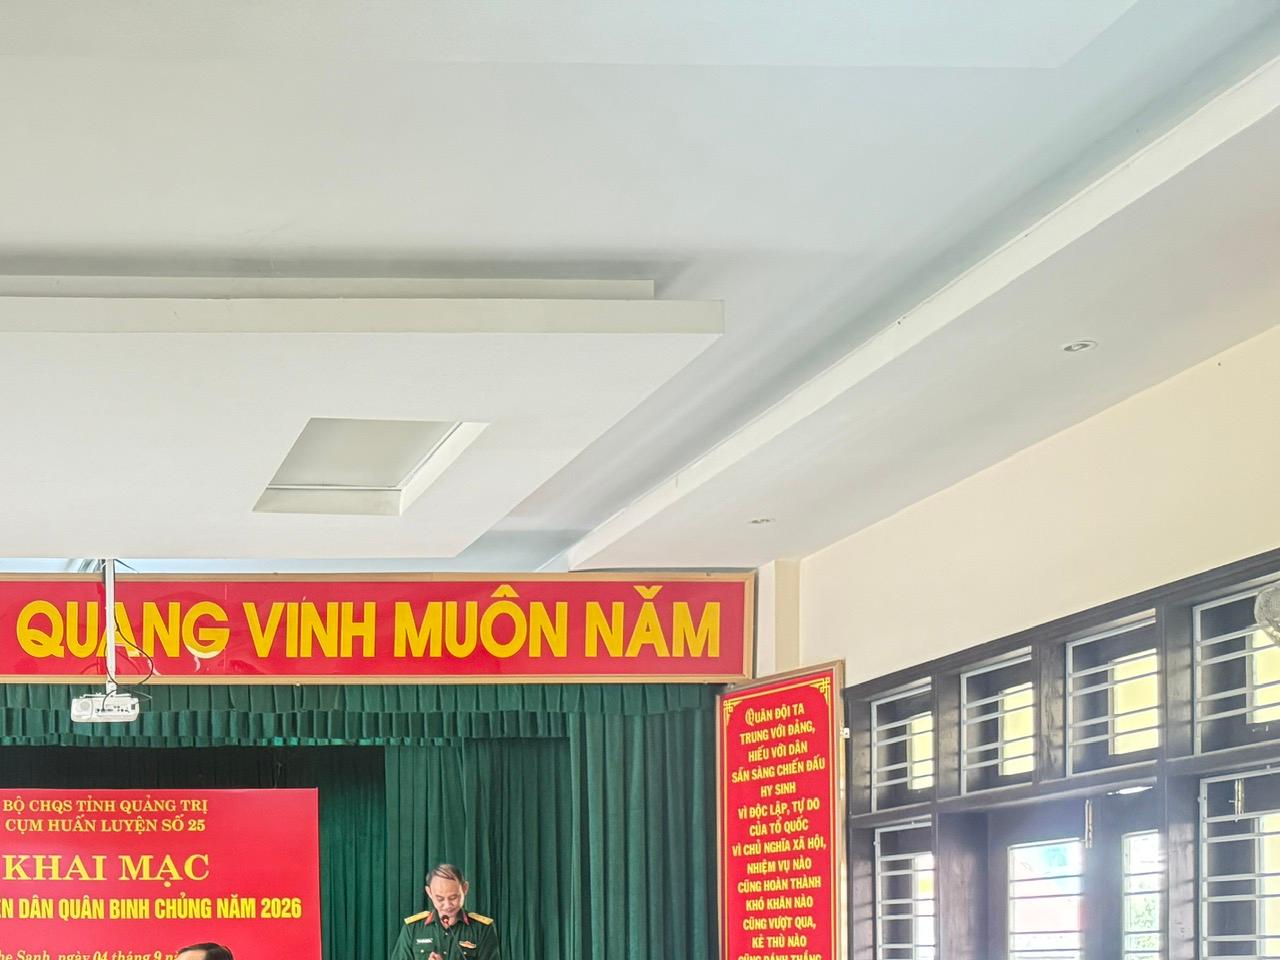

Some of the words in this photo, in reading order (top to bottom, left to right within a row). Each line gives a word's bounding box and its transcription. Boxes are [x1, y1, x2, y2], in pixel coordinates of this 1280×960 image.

[16, 599, 231, 659] QUANG
[243, 600, 377, 659] VINH
[394, 584, 568, 659] MUÔN
[586, 584, 721, 659] NĂM
[775, 704, 790, 720] ĐỘI
[792, 703, 804, 715] TA
[740, 729, 769, 745] TRUNG
[771, 723, 786, 739] VỚI
[788, 719, 815, 735] ĐẢNG,
[748, 745, 769, 762] HIẾU
[789, 739, 808, 755] DÂN
[751, 765, 775, 780] SÀNG
[777, 757, 804, 776] CHIẾN
[806, 754, 825, 771] ĐẤU
[761, 785, 773, 797] HY
[775, 782, 796, 795] SINH
[3, 796, 24, 815] BỘ
[29, 800, 72, 814] CHQS
[77, 795, 115, 812] TỈNH
[120, 794, 176, 814] QUẢNG
[180, 799, 208, 814] TRỊ
[738, 805, 747, 819] VÌ
[749, 803, 768, 819] ĐỘC
[770, 801, 790, 816] LẬP,
[792, 797, 805, 814] TỰ
[5, 819, 43, 834] CỤM
[48, 814, 95, 832] HUẤN
[102, 816, 158, 834] LUYỆN
[162, 814, 184, 831] SỐ
[188, 819, 206, 831] 25
[749, 820, 767, 836] CỦA
[769, 816, 782, 834] TỔ
[784, 815, 809, 834] QUỐC
[732, 842, 741, 856] VÌ
[743, 839, 761, 855] CHỦ
[764, 838, 790, 853] NGHĨA
[793, 836, 805, 851] XÃ
[808, 834, 826, 851] HỘI,
[2, 854, 107, 880] KHAI
[118, 854, 209, 888] MẠC
[747, 859, 776, 875] NHIỆM
[778, 860, 790, 873] VỤ
[793, 855, 812, 870] NÀO
[738, 879, 761, 893] CŨNG
[764, 876, 788, 891] HOÀN
[790, 874, 821, 889] THÀNH
[19, 894, 53, 919] DÂN
[58, 895, 105, 921] QUÂN
[109, 899, 150, 919] BINH
[155, 892, 212, 919] CHỦNG
[217, 894, 256, 918] NĂM
[261, 898, 301, 918] 2026
[746, 896, 764, 911] KHÓ
[767, 896, 792, 910] KHĂN
[794, 893, 813, 908] NÀO
[743, 917, 767, 930] CŨNG
[768, 915, 792, 931] VƯỢT
[795, 916, 816, 930] QUA,
[752, 934, 765, 948] KẺ
[767, 933, 785, 948] THÙ
[788, 933, 807, 947] NÀO
